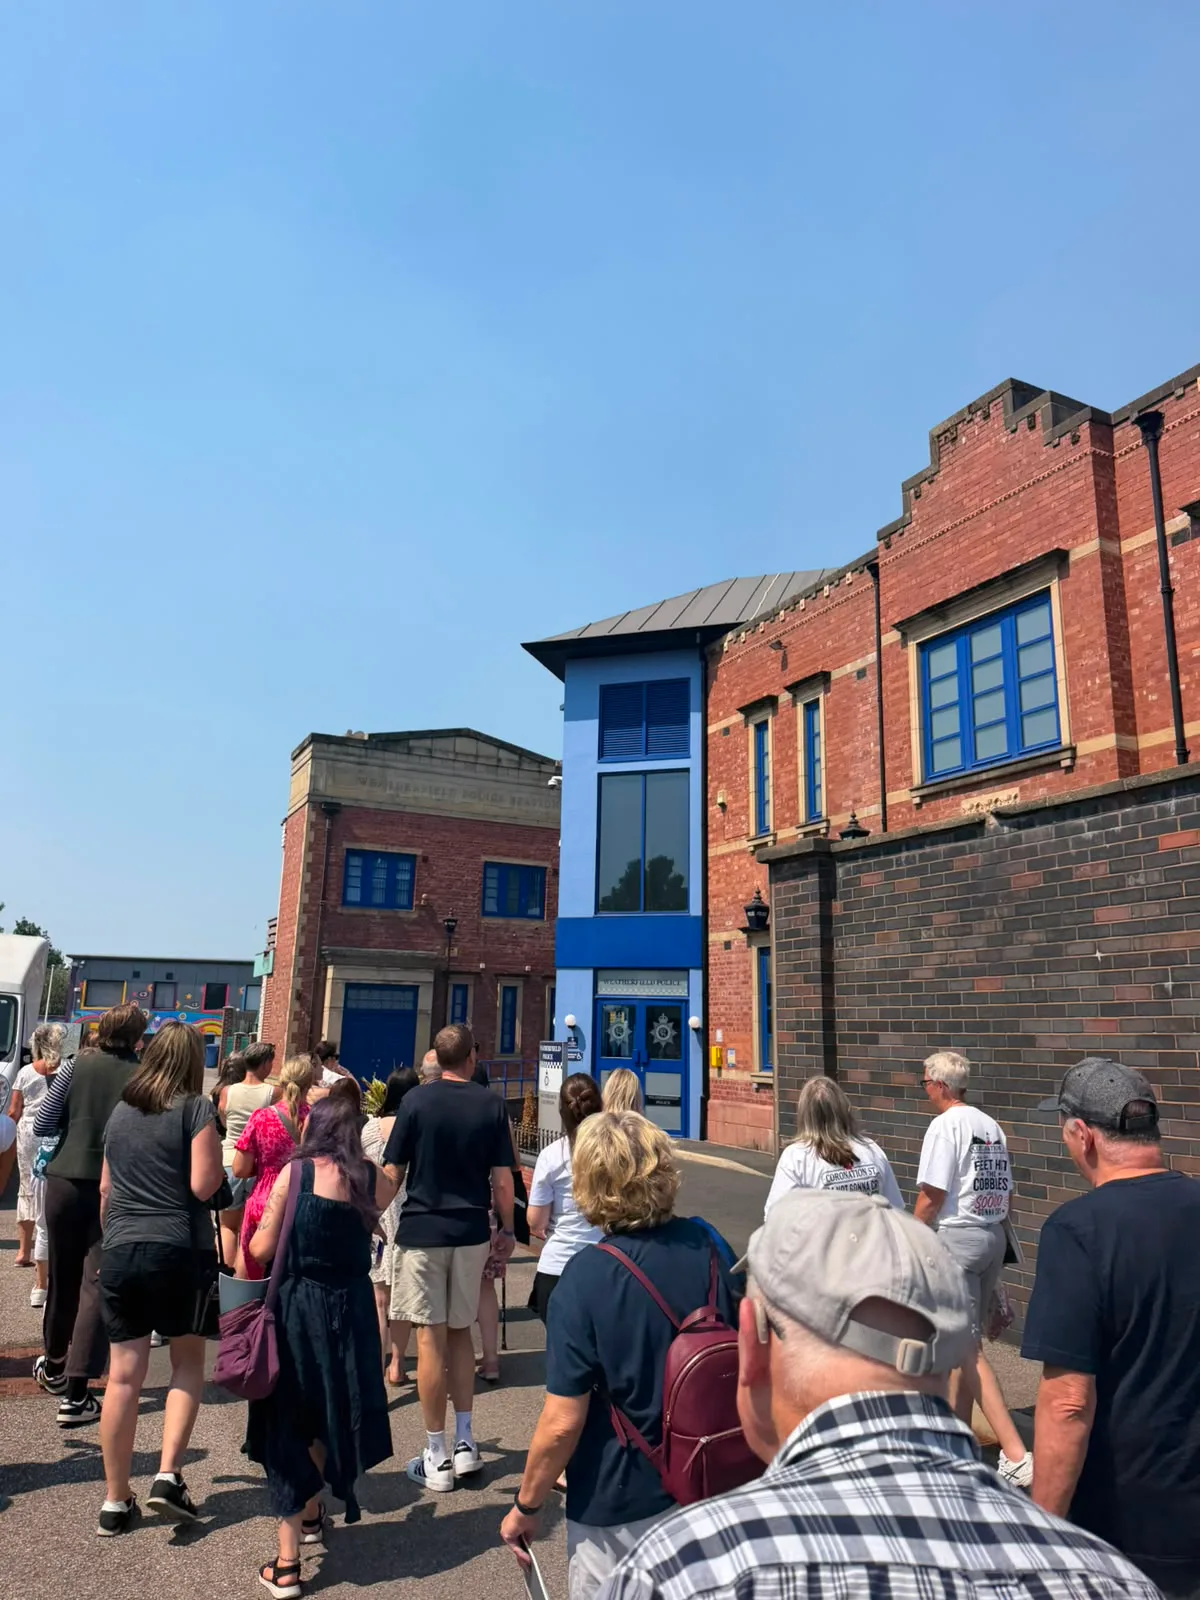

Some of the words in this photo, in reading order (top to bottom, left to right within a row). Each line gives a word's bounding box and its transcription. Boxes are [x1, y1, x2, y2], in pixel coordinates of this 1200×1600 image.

[974, 1160, 993, 1172] FEET
[995, 1160, 1008, 1172] HIT
[825, 1167, 867, 1183] CORONATION
[868, 1167, 877, 1176] ST
[985, 1170, 997, 1178] THE
[972, 1177, 1009, 1192] COBBLES
